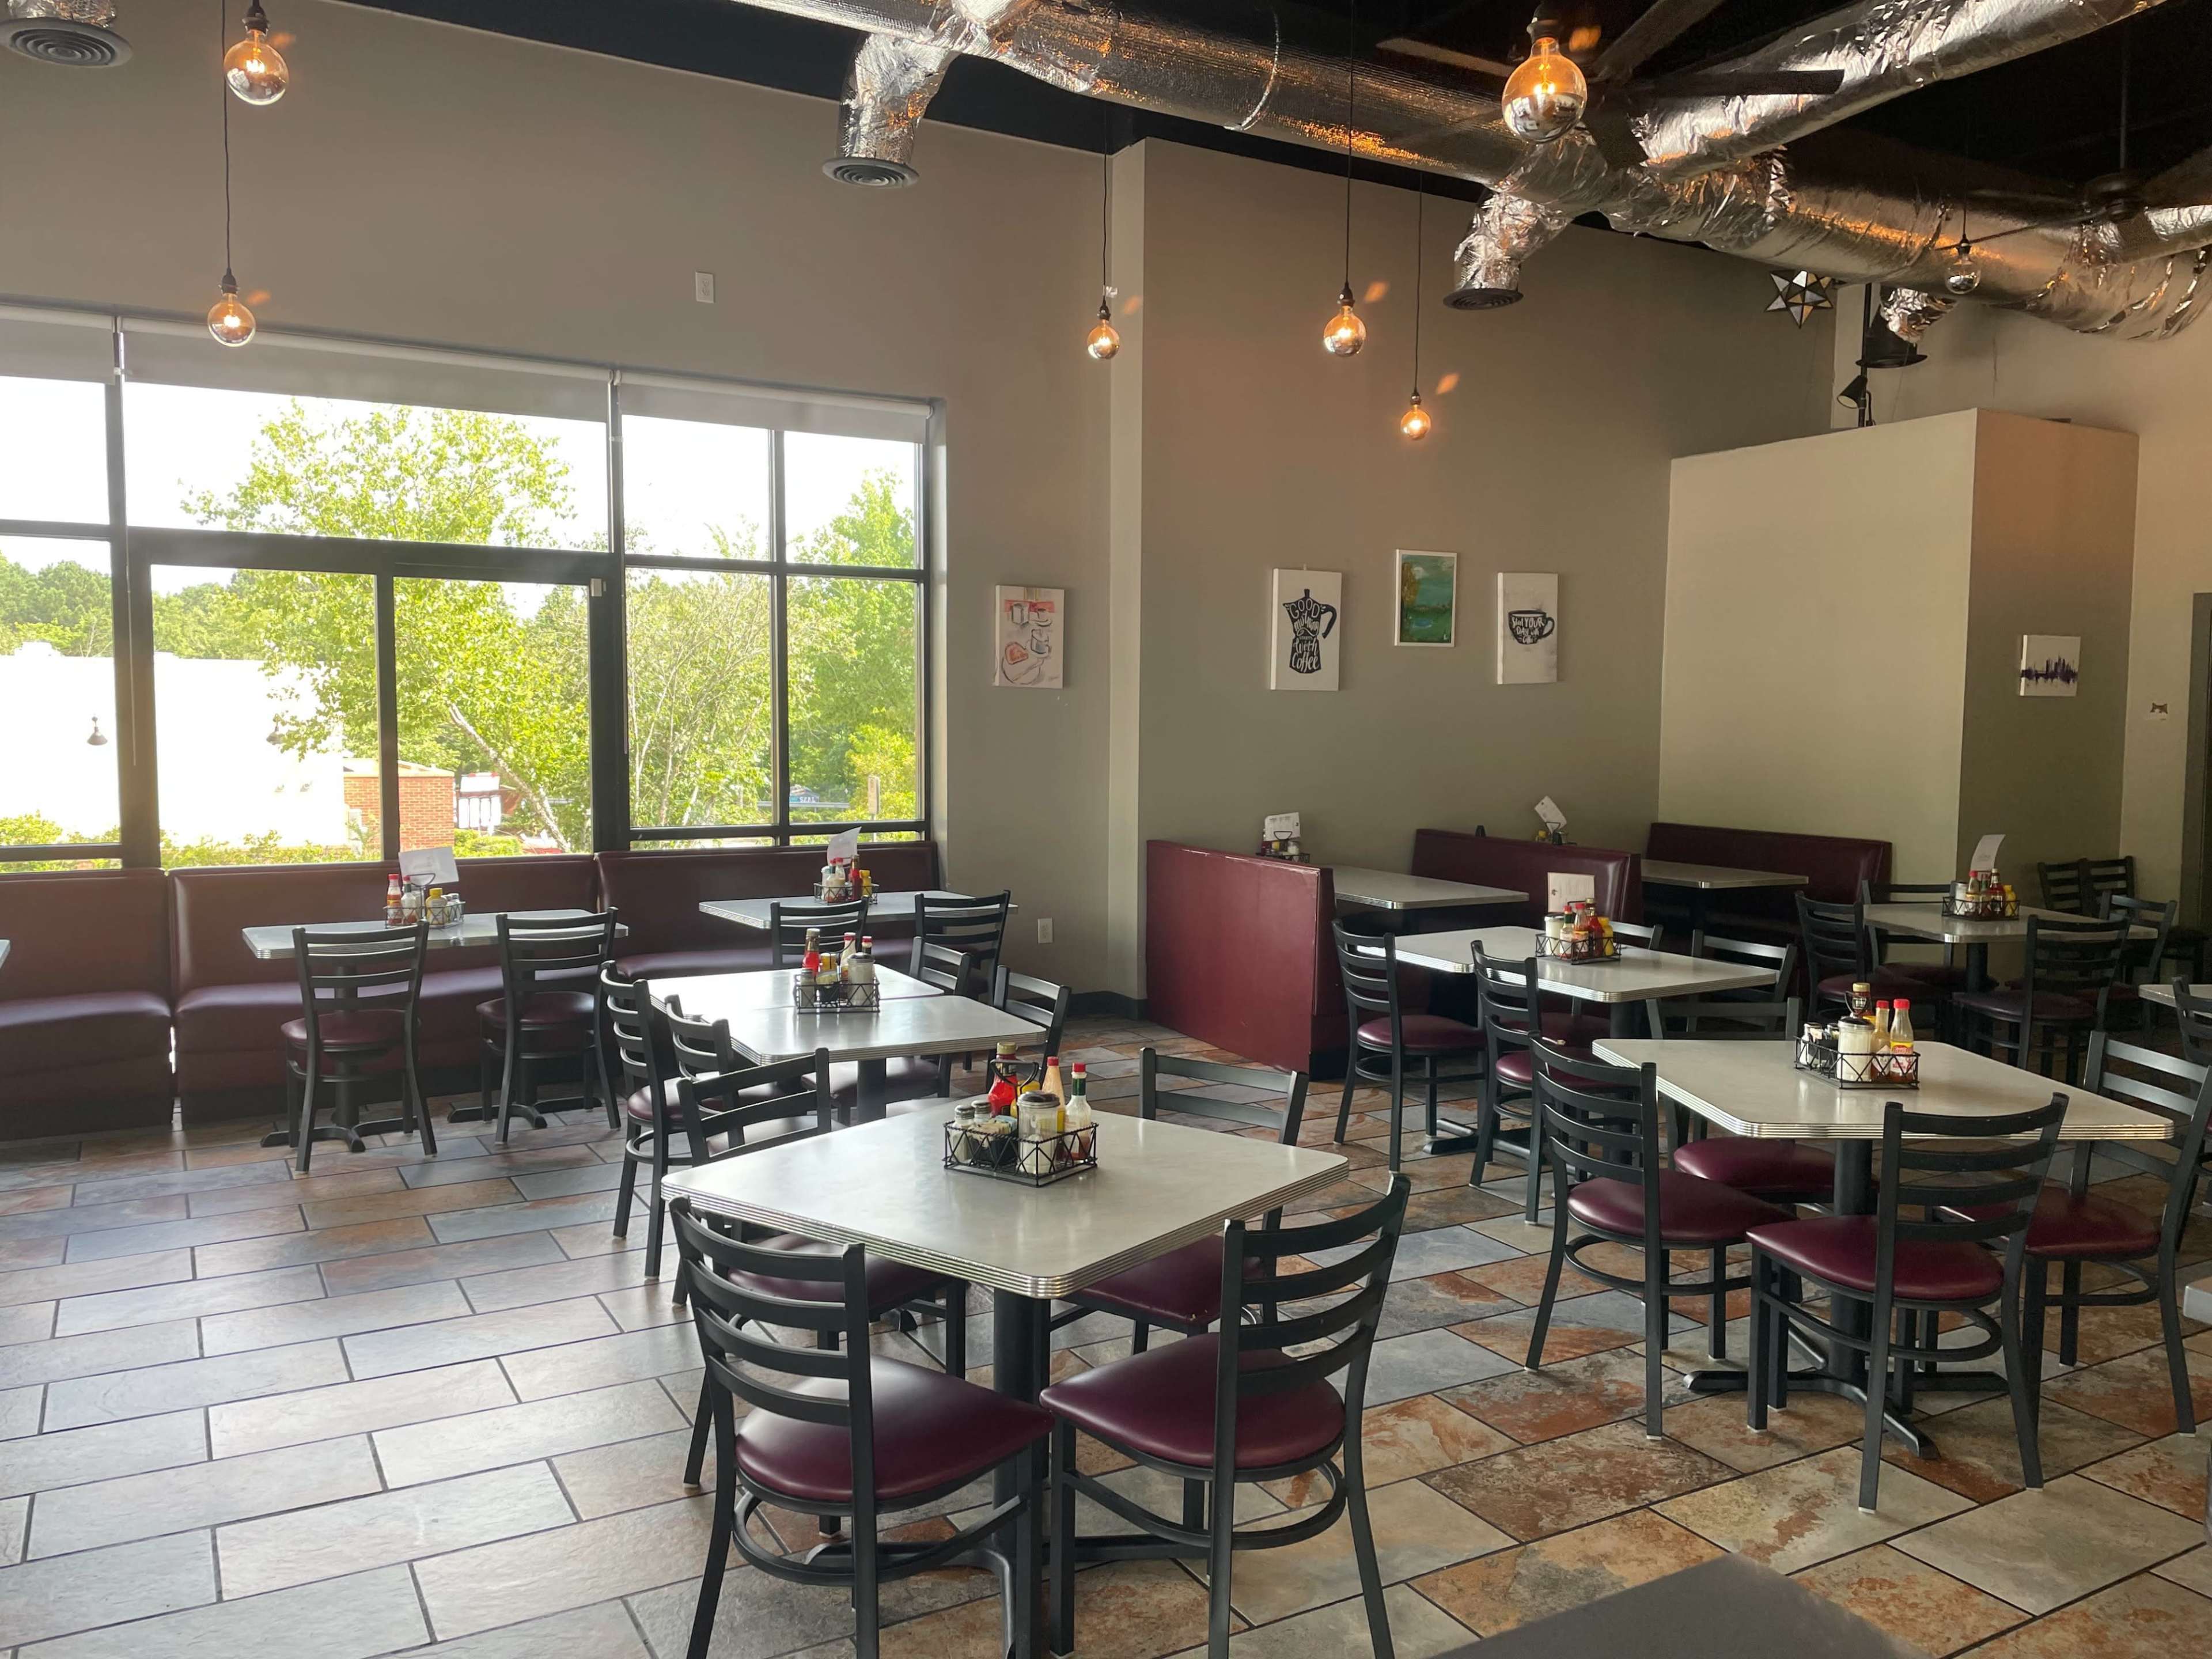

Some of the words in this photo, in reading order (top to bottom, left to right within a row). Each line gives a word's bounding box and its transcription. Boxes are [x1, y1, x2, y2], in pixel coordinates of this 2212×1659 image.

[1290, 599, 1320, 619] GOOD
[1524, 616, 1545, 628] YOUR
[1291, 652, 1320, 673] Coffee
